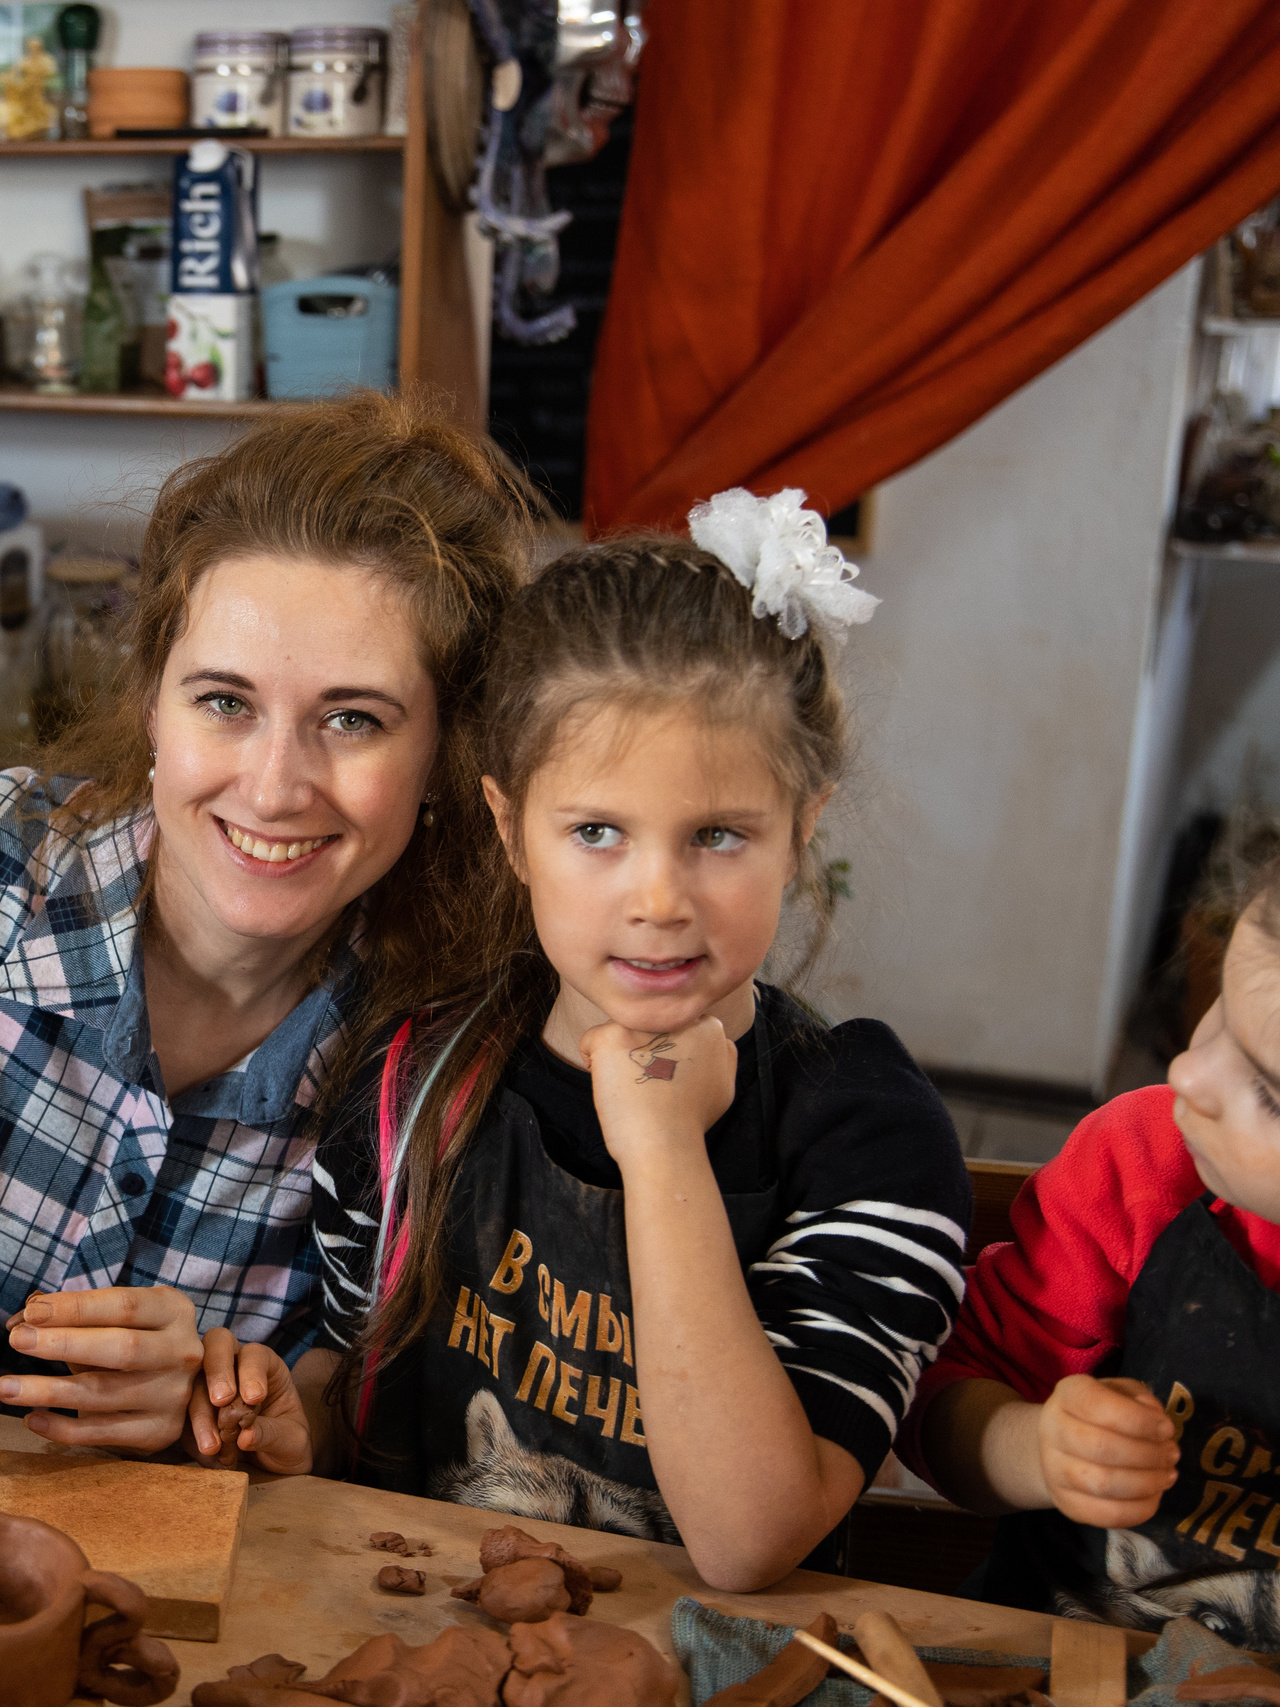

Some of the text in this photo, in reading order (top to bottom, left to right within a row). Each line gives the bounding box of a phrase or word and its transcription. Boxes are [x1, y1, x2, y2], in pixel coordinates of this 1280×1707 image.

[178, 181, 221, 288] Rich
[488, 1228, 533, 1295] В
[447, 1285, 516, 1379] НЕТ
